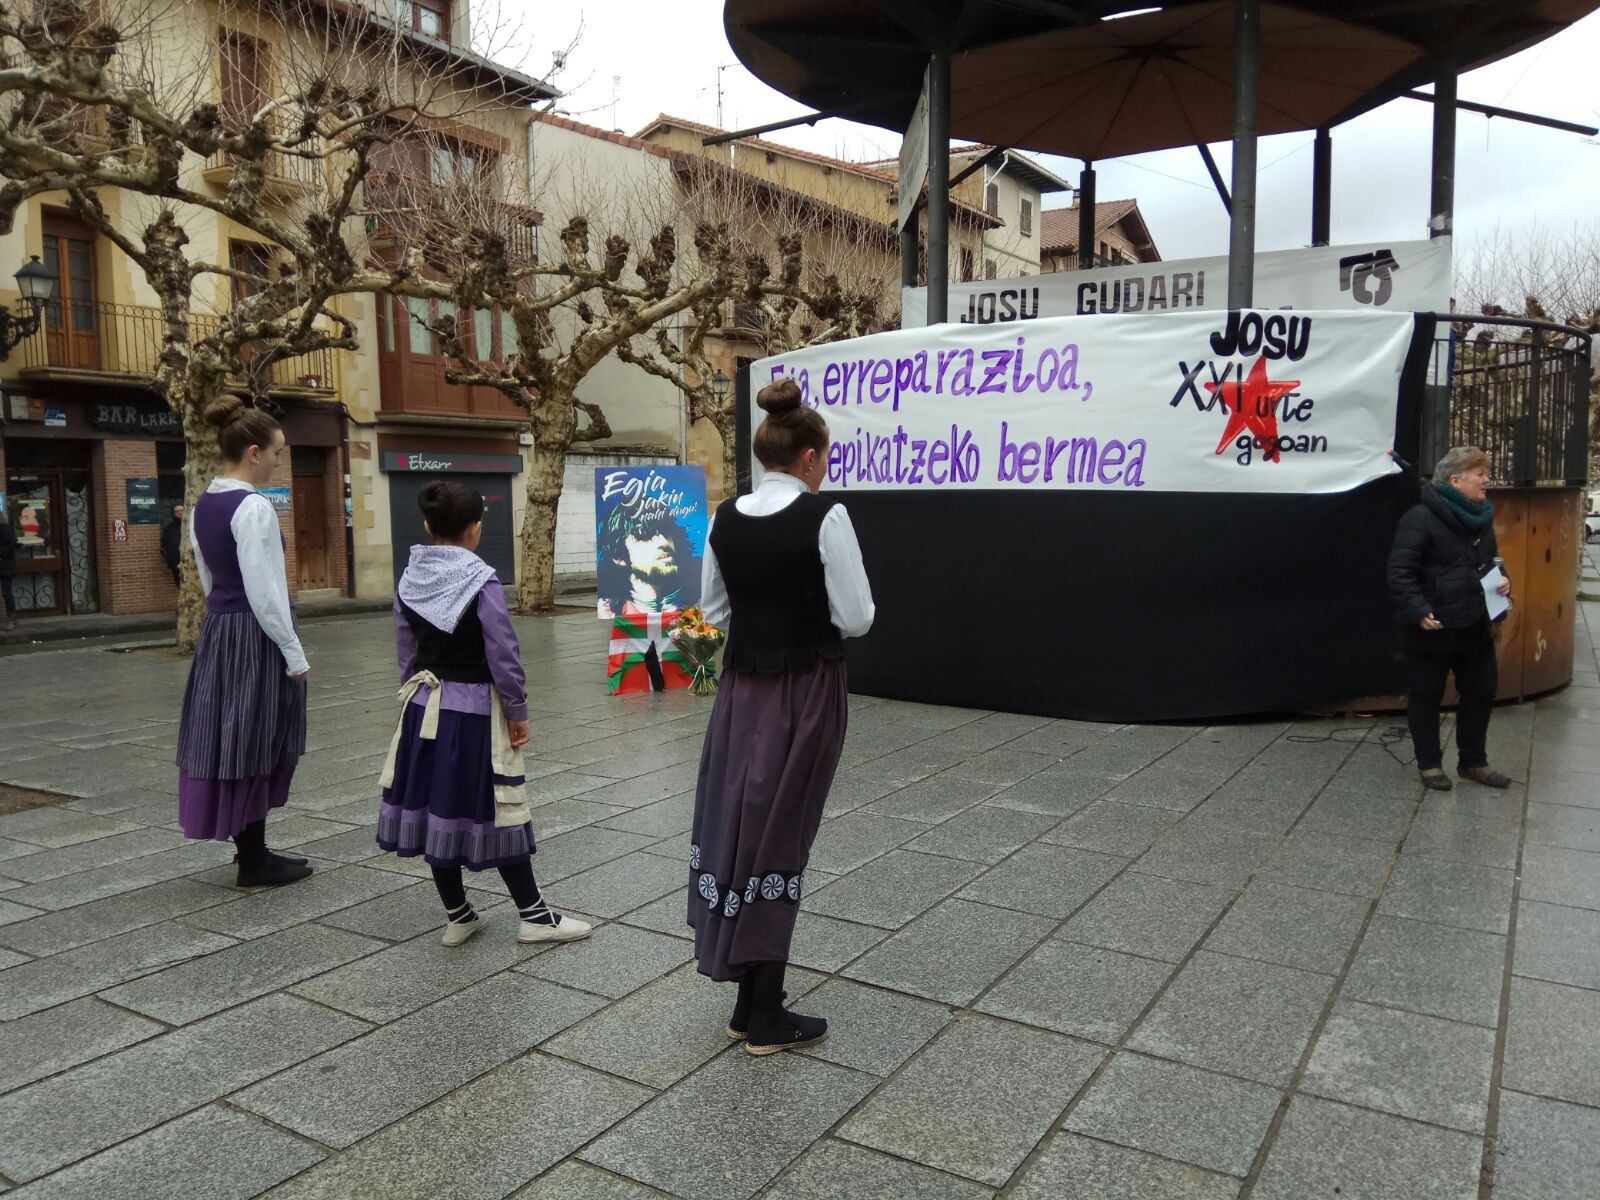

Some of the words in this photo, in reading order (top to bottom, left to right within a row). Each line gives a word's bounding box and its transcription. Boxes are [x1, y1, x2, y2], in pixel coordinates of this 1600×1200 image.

[960, 288, 1039, 324] JOSU
[1077, 270, 1205, 316] GUDARI
[1210, 311, 1312, 361] JOSU
[1169, 360, 1242, 415] XXI
[96, 404, 138, 424] BAR
[998, 421, 1147, 488] bermea
[1236, 434, 1328, 466] gogoan
[602, 469, 667, 507] Egia
[631, 489, 684, 519] jakin
